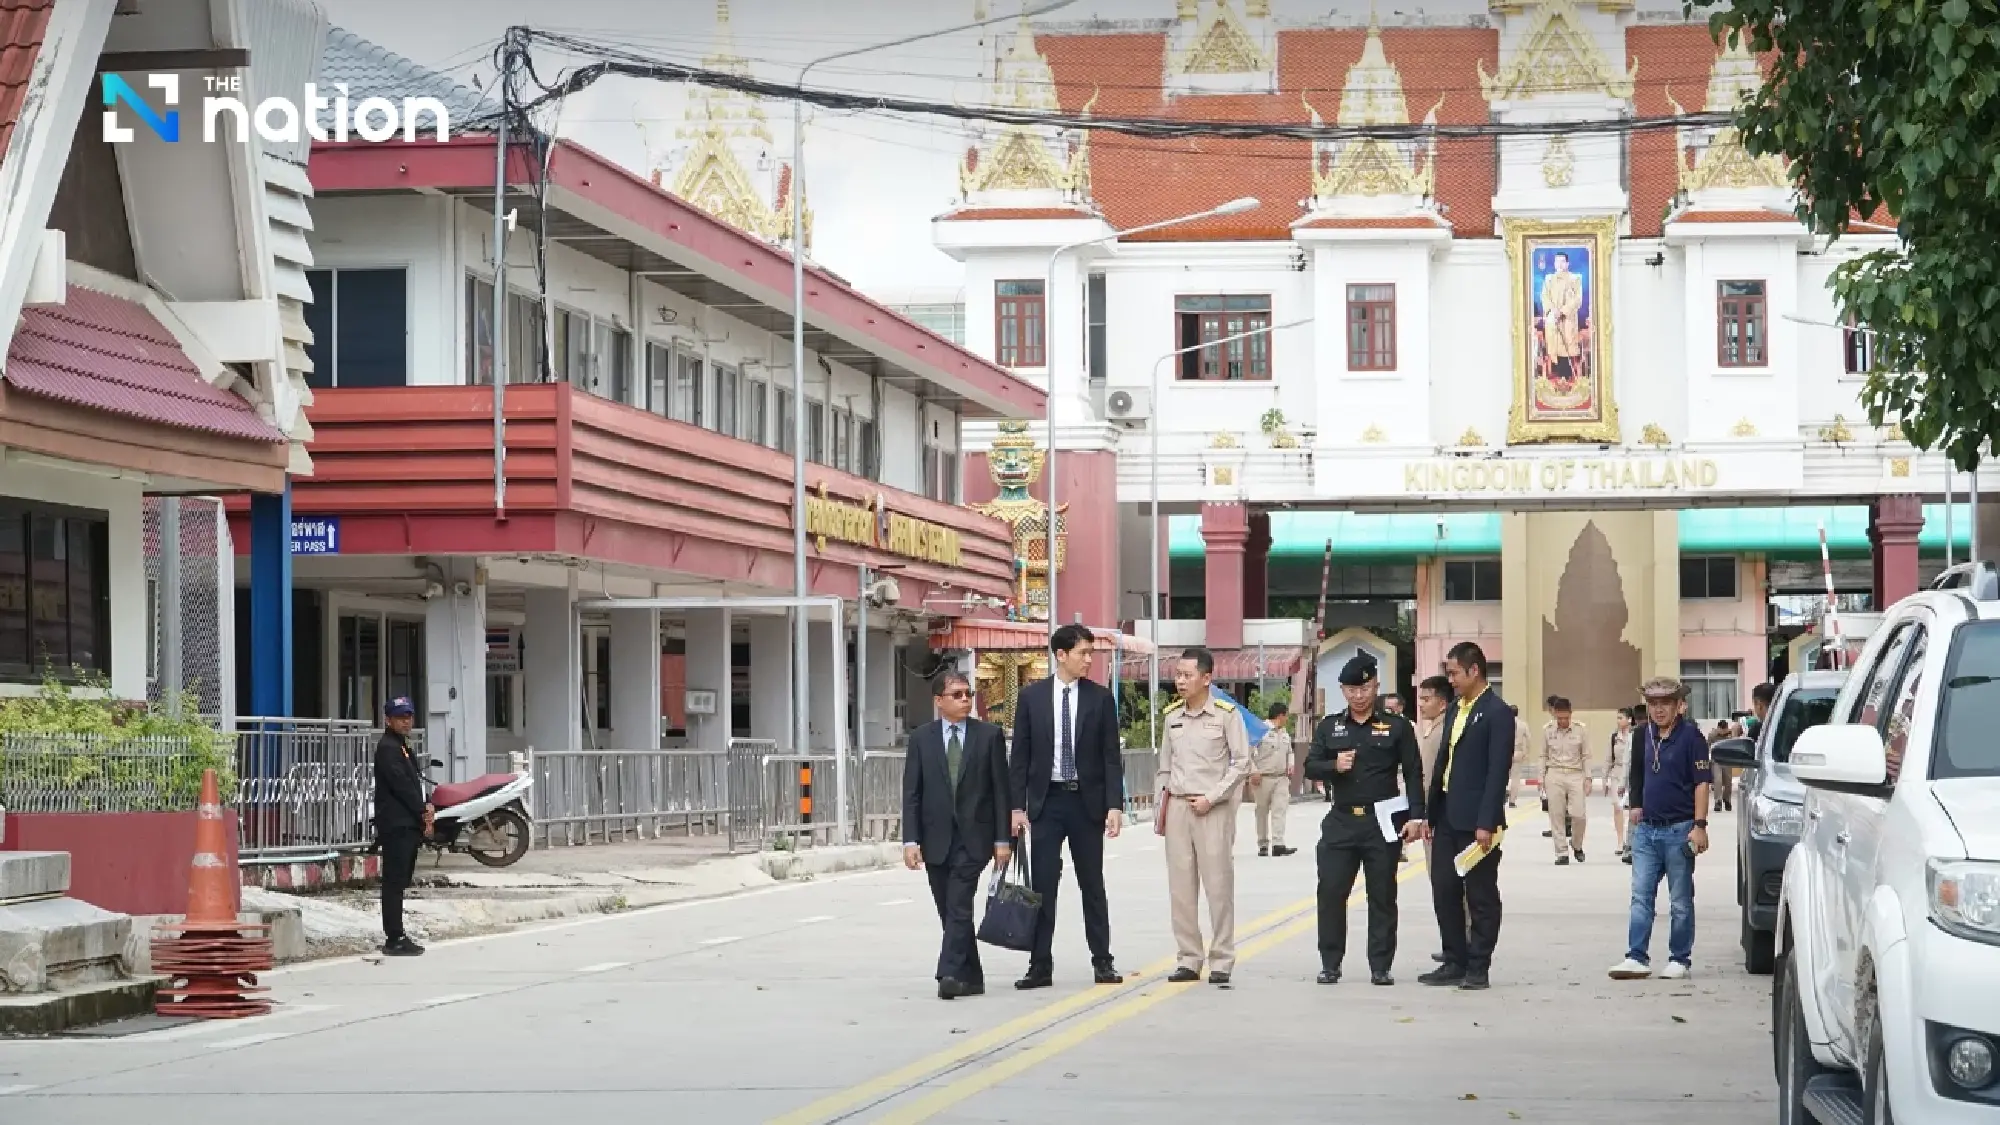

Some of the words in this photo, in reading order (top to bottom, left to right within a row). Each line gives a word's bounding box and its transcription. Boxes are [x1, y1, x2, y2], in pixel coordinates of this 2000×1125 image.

[1404, 462, 1532, 492] KINGDOM
[1539, 461, 1575, 491] OF
[1583, 459, 1719, 490] THAILAND
[304, 541, 326, 552] PASS
